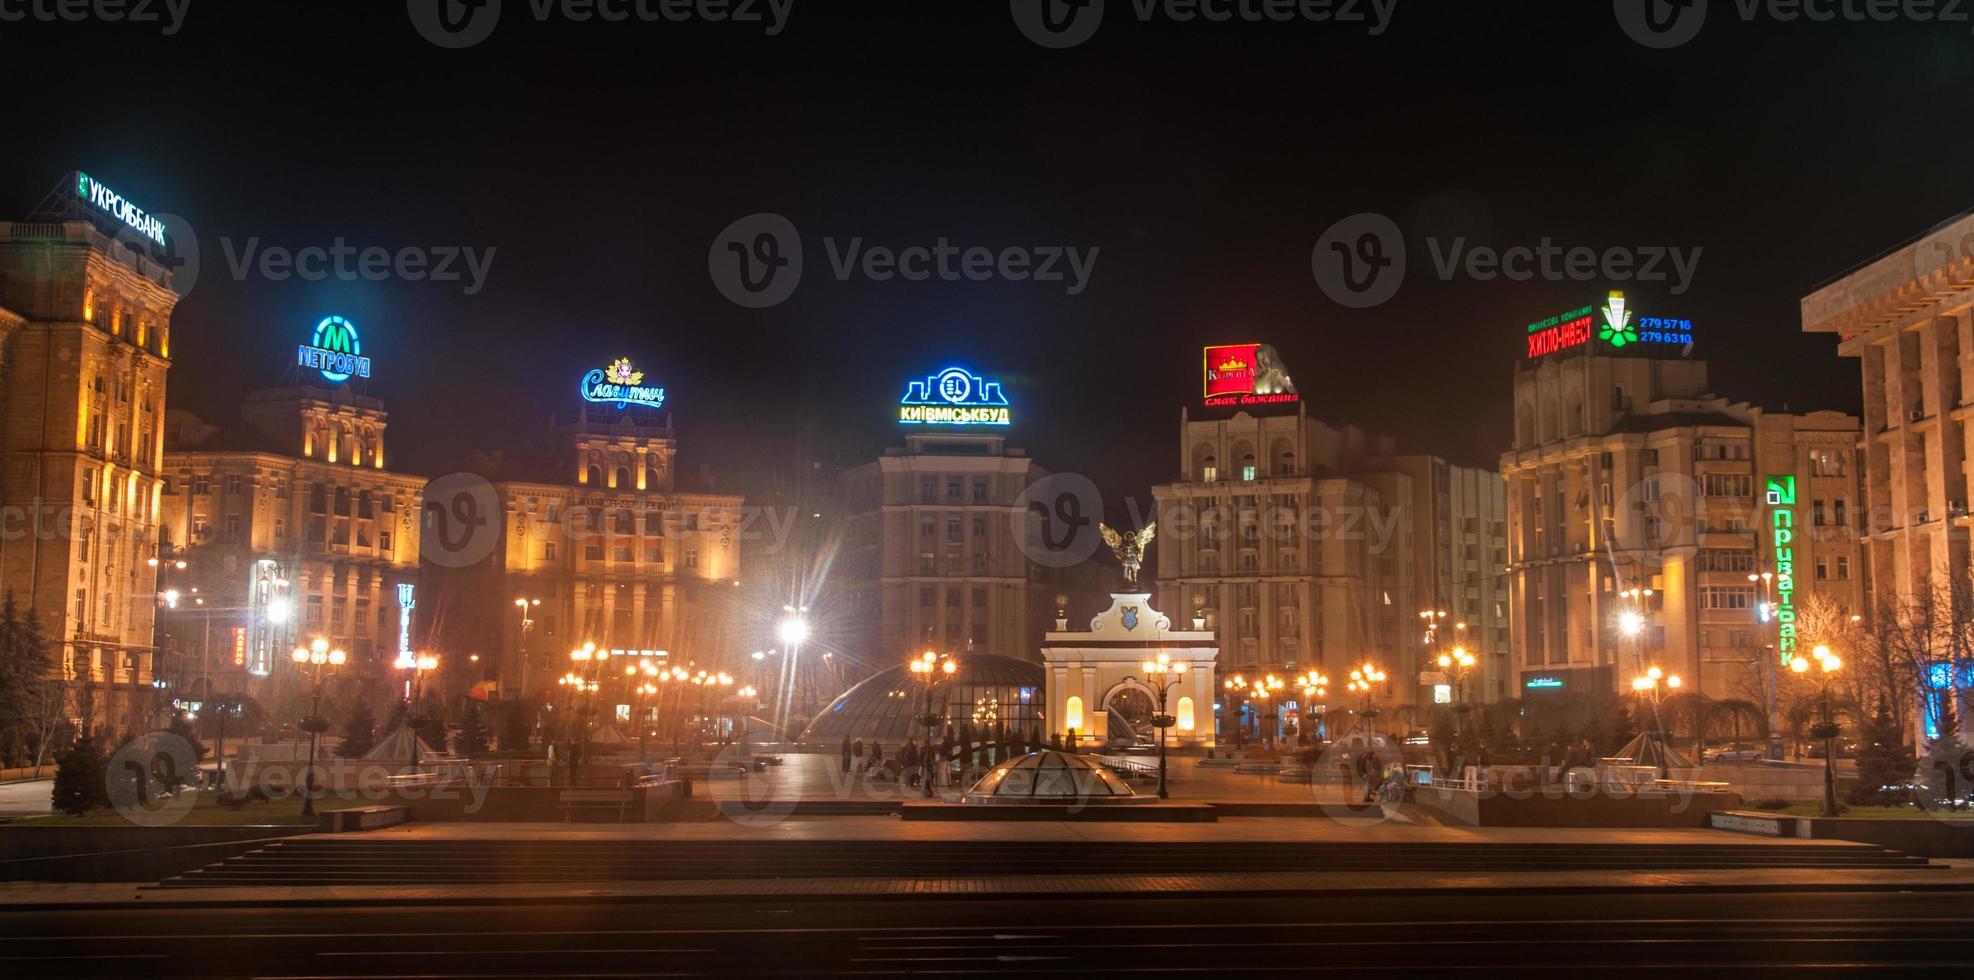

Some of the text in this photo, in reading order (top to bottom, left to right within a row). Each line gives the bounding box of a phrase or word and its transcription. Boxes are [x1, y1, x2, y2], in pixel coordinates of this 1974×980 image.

[89, 177, 166, 246] УКРСИББАНК
[1640, 318, 1661, 329] 279
[1528, 316, 1592, 358] ЖИТЛО-ІНВЕСТ
[1640, 332, 1661, 342] 279
[299, 345, 370, 378] МЕТРОБУД
[1205, 396, 1237, 406] смак
[901, 406, 1008, 422] КИЇВМІСЬКБУД
